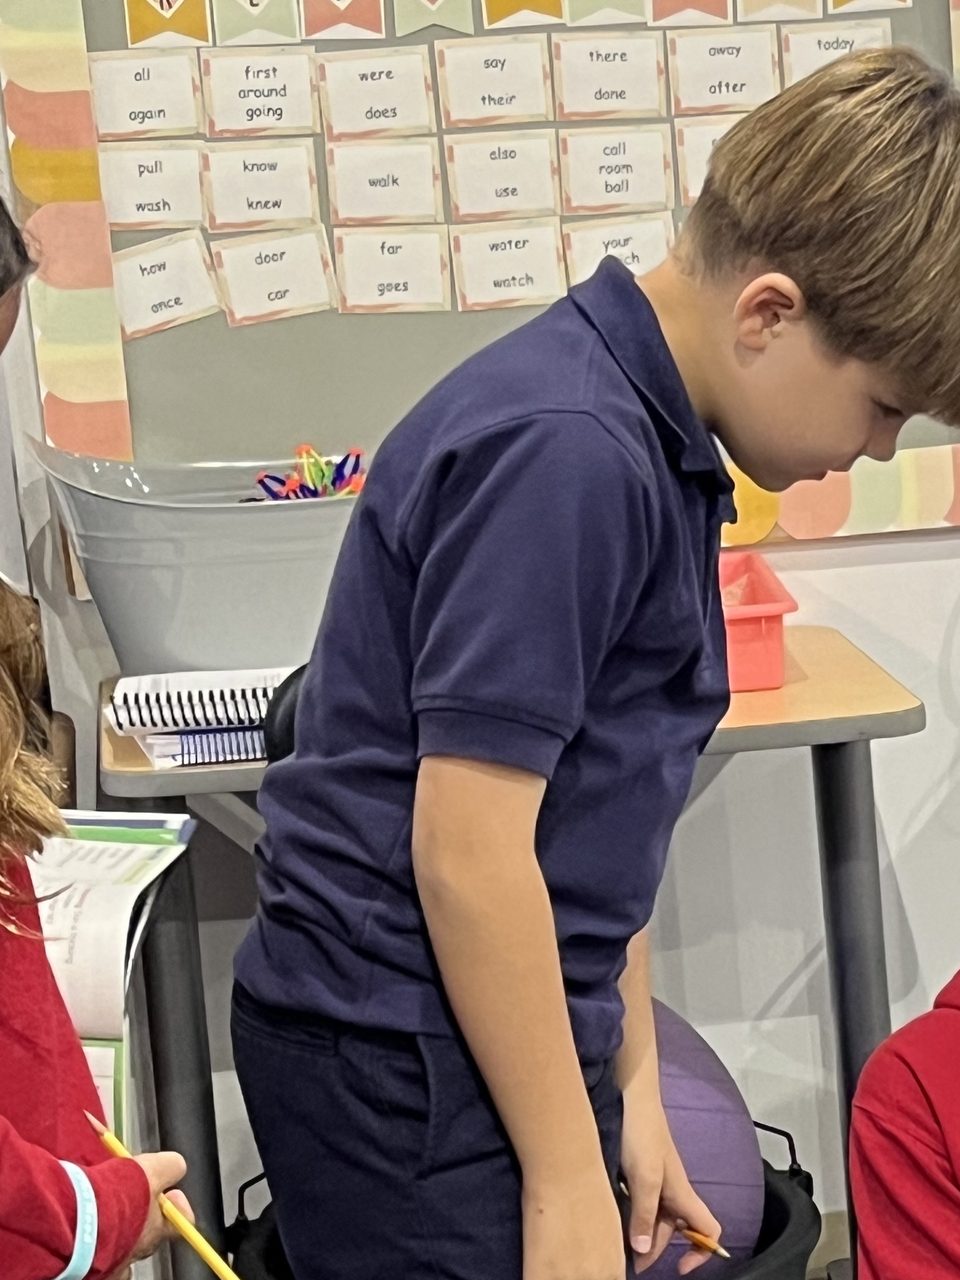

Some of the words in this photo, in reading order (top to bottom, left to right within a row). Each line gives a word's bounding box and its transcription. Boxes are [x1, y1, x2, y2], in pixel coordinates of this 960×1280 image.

[708, 46, 742, 58] away
[817, 37, 855, 52] today
[588, 50, 628, 63] there
[483, 58, 507, 72] say
[133, 67, 151, 82] all
[244, 65, 278, 81] first
[358, 70, 395, 82] were
[238, 83, 288, 100] around
[593, 87, 627, 101] done
[708, 80, 747, 95] after
[480, 93, 517, 106] their
[128, 108, 166, 125] again
[245, 107, 283, 122] going
[364, 106, 398, 120] does
[602, 141, 626, 157] call
[137, 160, 163, 178] pull
[242, 160, 278, 173] know
[598, 163, 634, 175] room
[368, 173, 400, 188] walk
[604, 178, 629, 194] ball
[494, 186, 519, 198] use
[135, 198, 172, 212] wash
[246, 197, 282, 210] knew
[379, 241, 403, 256] far
[488, 239, 530, 252] water
[602, 236, 633, 254] your
[254, 251, 287, 266] door
[138, 261, 167, 277] how
[492, 272, 534, 289] watch
[267, 288, 290, 302] car
[376, 281, 409, 297] goes
[150, 296, 184, 314] once
